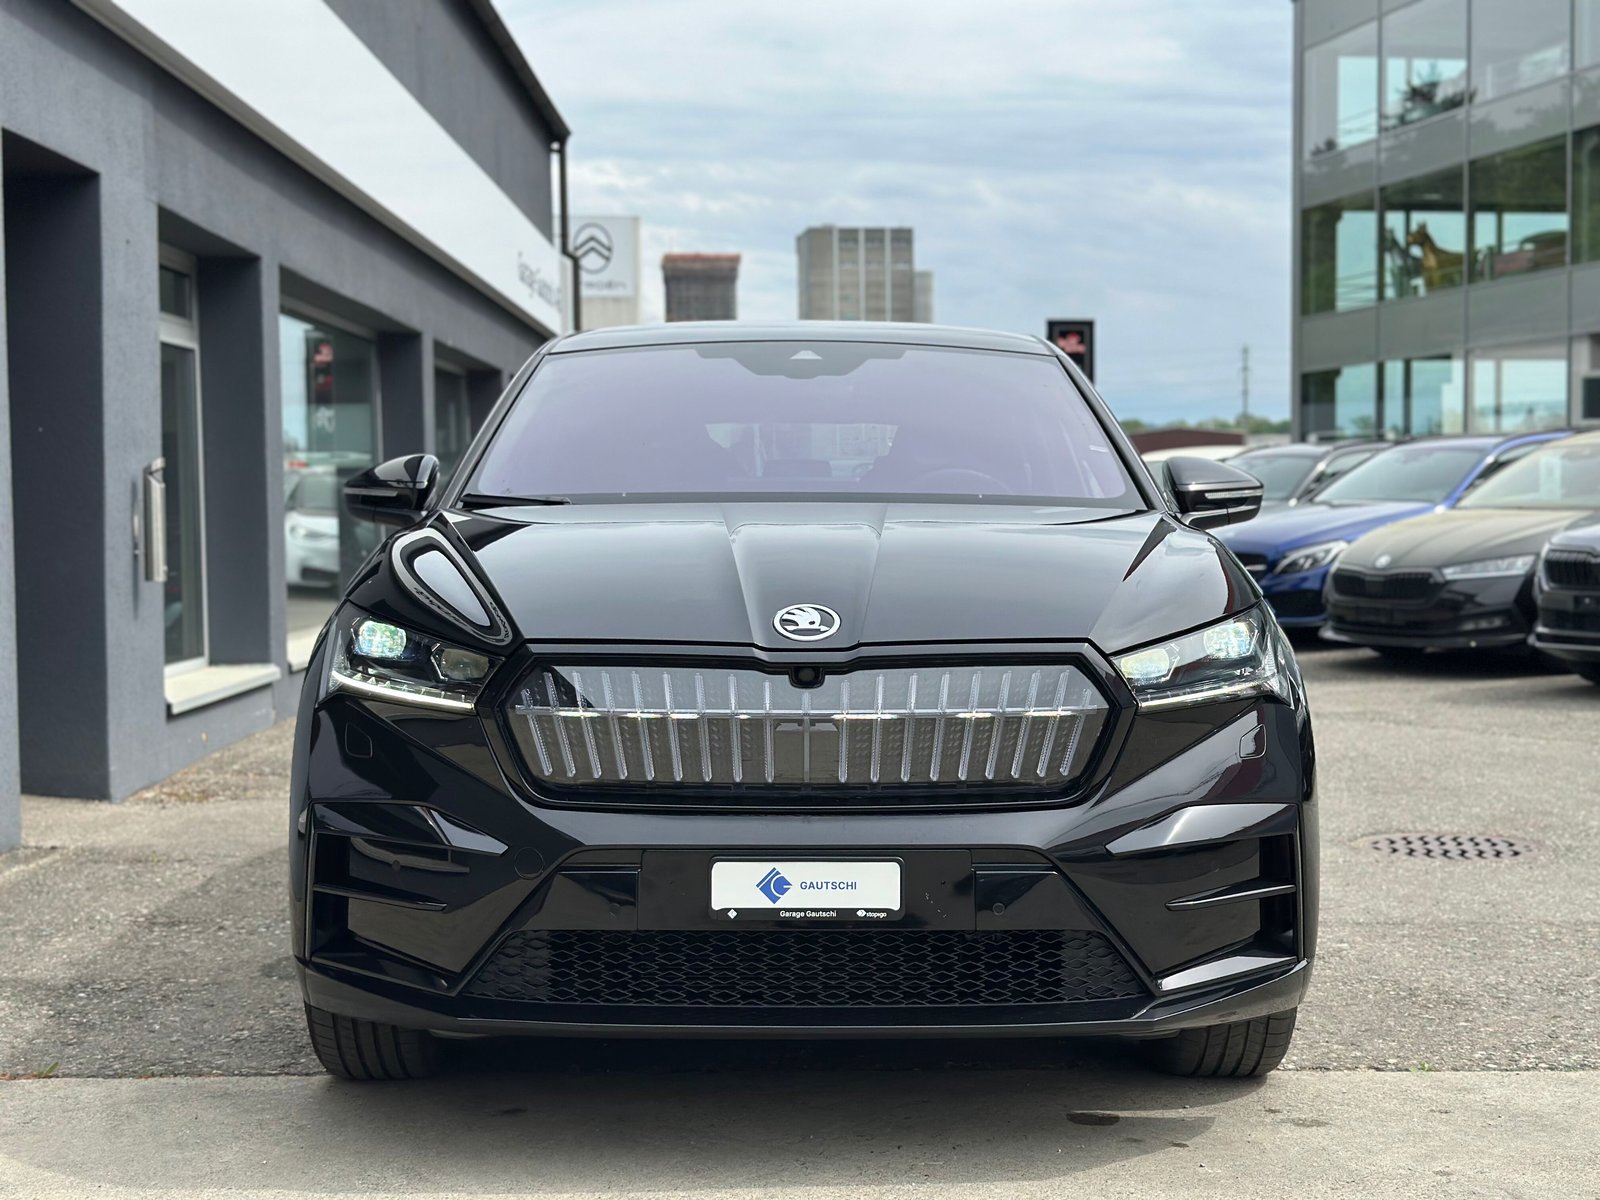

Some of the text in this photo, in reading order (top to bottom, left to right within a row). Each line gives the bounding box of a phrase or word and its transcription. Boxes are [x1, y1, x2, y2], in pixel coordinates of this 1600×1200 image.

[800, 882, 857, 890] GAUTSCHI
[780, 910, 837, 918] Garage Gautschi
